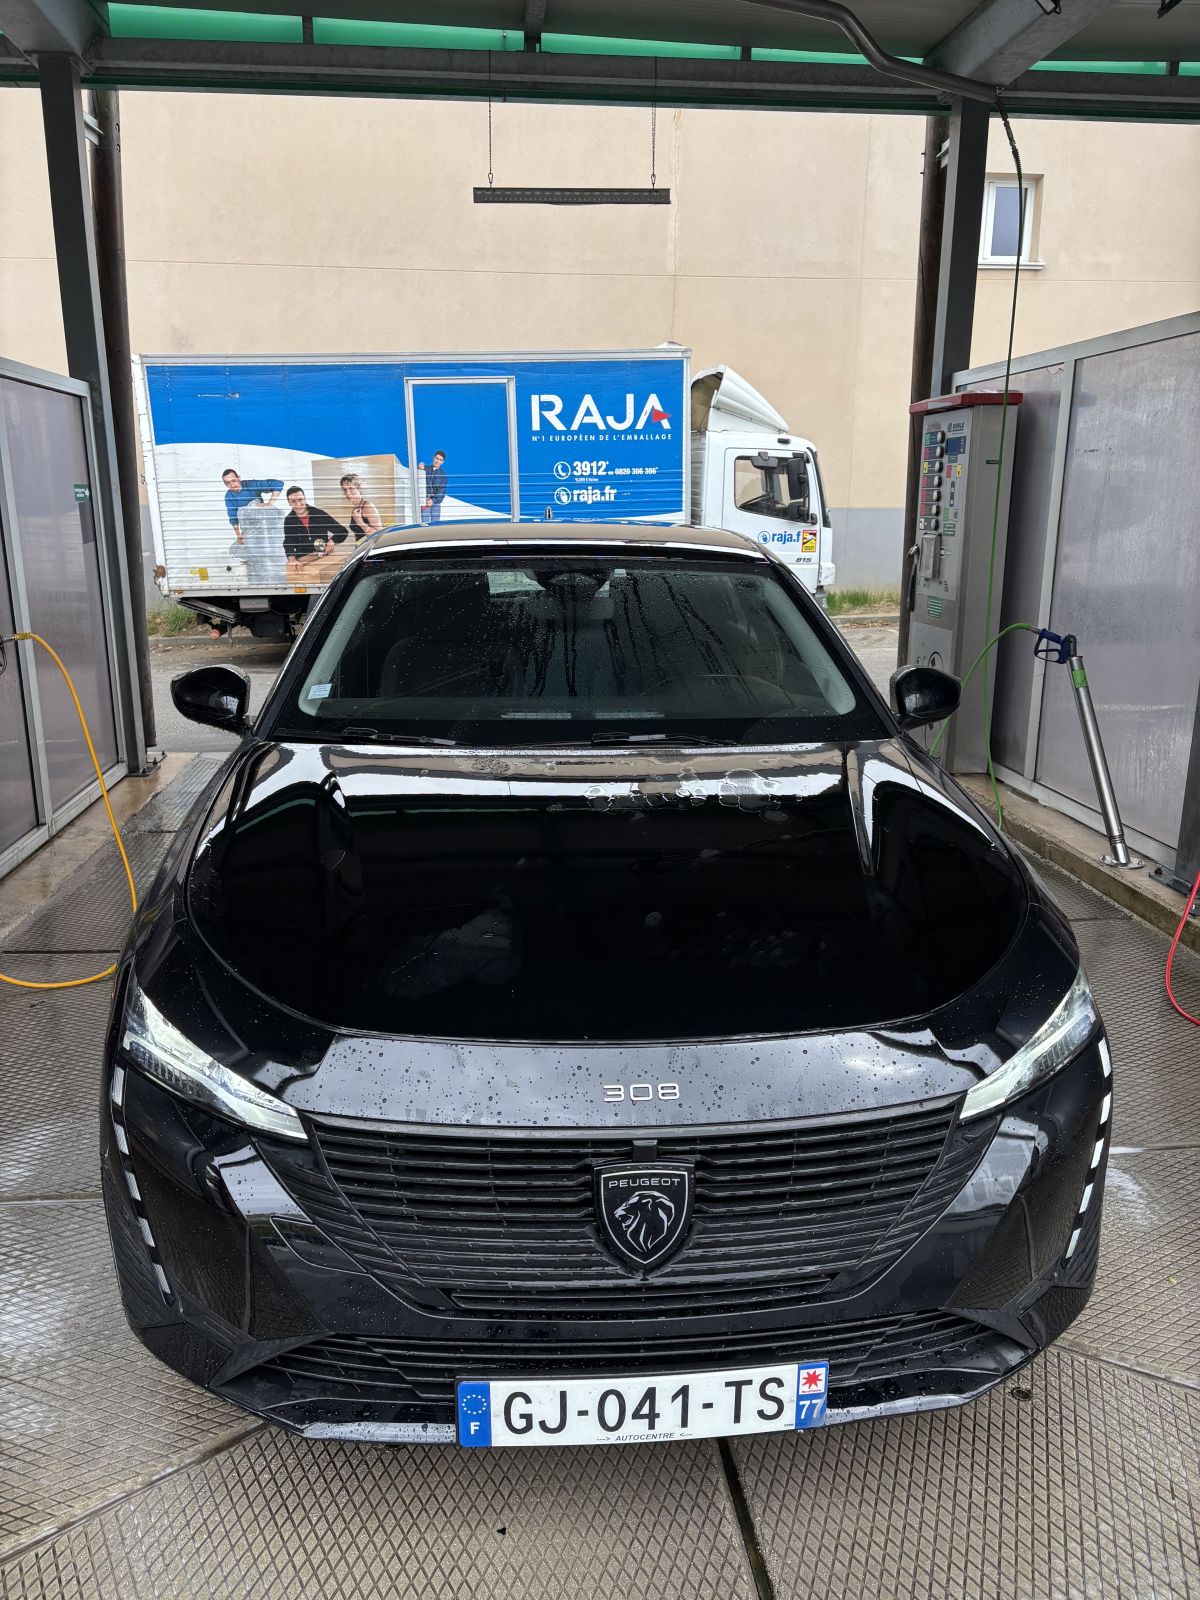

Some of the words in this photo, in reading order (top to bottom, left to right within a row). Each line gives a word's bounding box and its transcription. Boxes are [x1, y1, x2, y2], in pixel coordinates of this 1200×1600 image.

[531, 393, 672, 431] RAJA
[613, 433, 672, 441] L'EMBALLAGE
[573, 485, 617, 505] raja.fr
[771, 530, 802, 544] raja.f
[603, 1083, 680, 1102] 308
[608, 1178, 681, 1189] PEUGEOT
[503, 1376, 786, 1435] GJ-041-TS
[799, 1398, 824, 1420] 77
[469, 1421, 481, 1436] F
[615, 1432, 675, 1442] AUTOCENTRE
